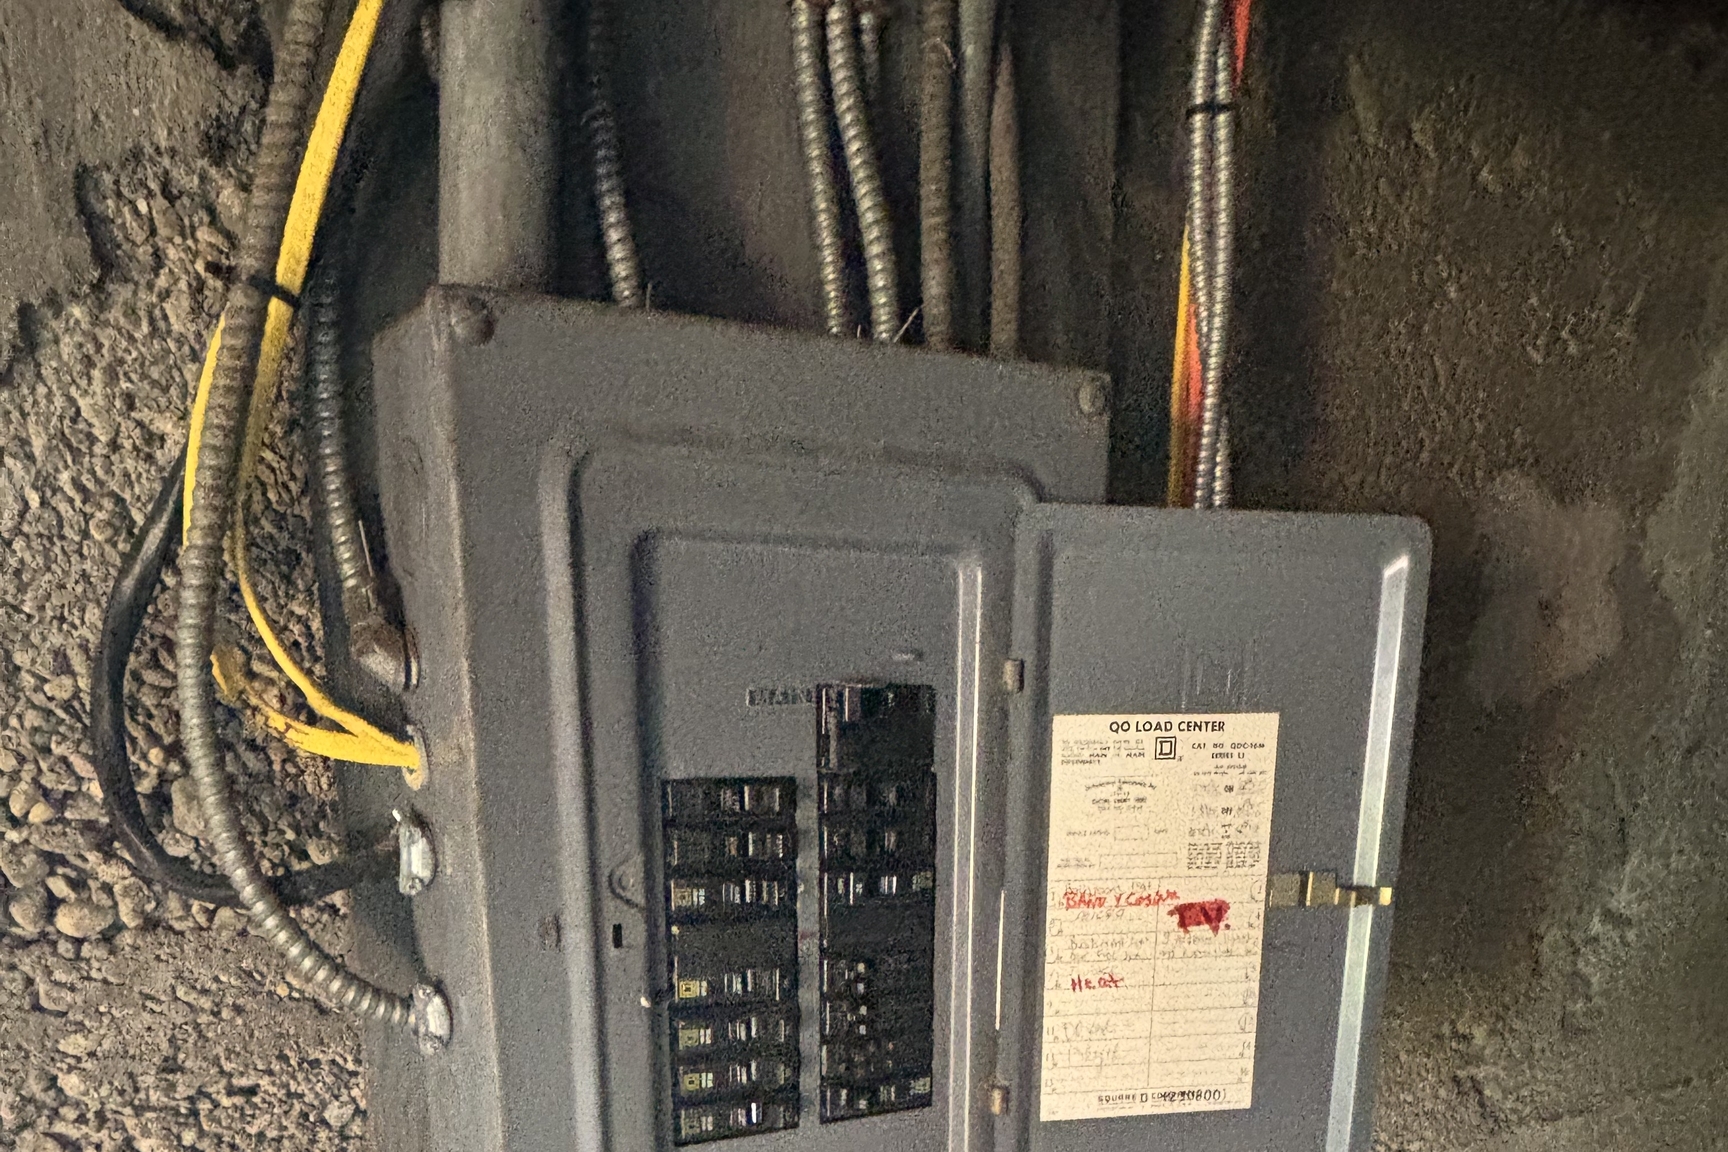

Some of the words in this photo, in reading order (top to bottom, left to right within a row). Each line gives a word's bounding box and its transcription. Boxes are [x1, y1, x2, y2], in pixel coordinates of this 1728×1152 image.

[1109, 720, 1131, 734] QO
[1135, 720, 1173, 732] LOAD
[1177, 720, 1226, 732] CENTER
